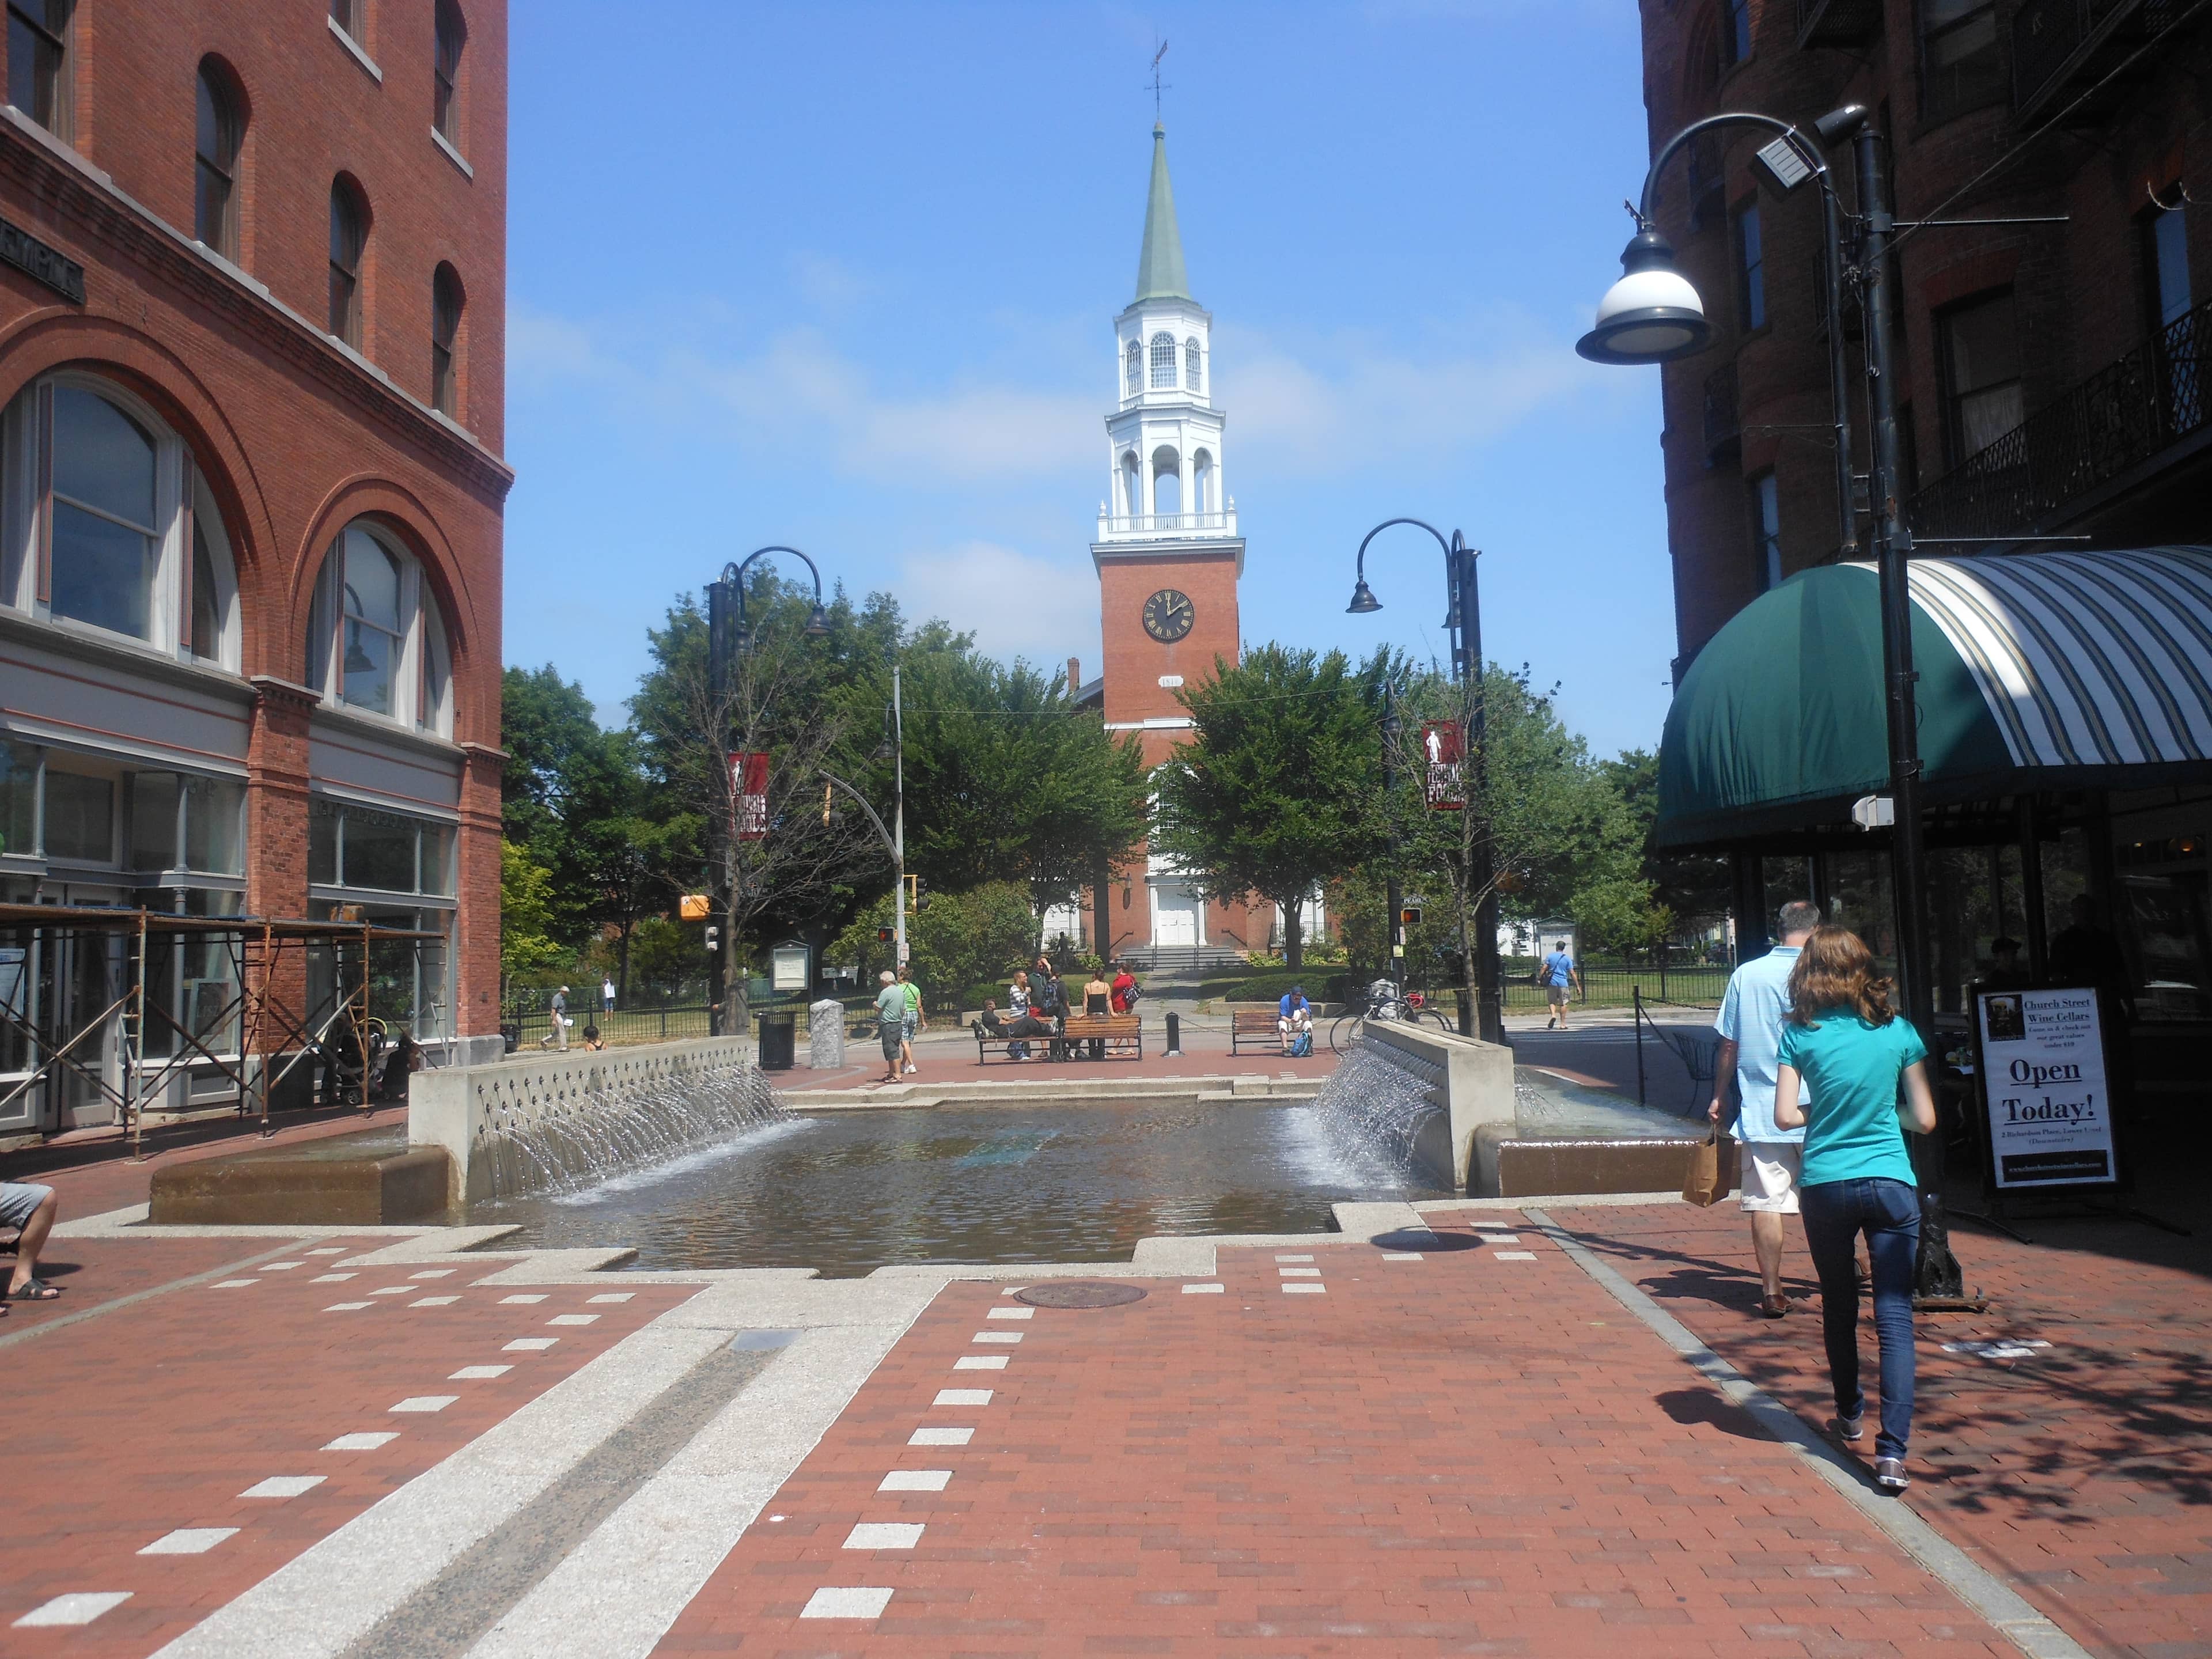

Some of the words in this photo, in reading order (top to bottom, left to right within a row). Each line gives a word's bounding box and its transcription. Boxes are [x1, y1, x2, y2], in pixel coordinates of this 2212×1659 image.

[2024, 999, 2060, 1009] Church
[2062, 998, 2090, 1007] Street
[2028, 1013, 2054, 1022] Wine
[2057, 1012, 2090, 1021] Cellars
[2010, 1059, 2081, 1088] Open
[2002, 1094, 2094, 1125] Today!
[2007, 1130, 2041, 1138] Richardson
